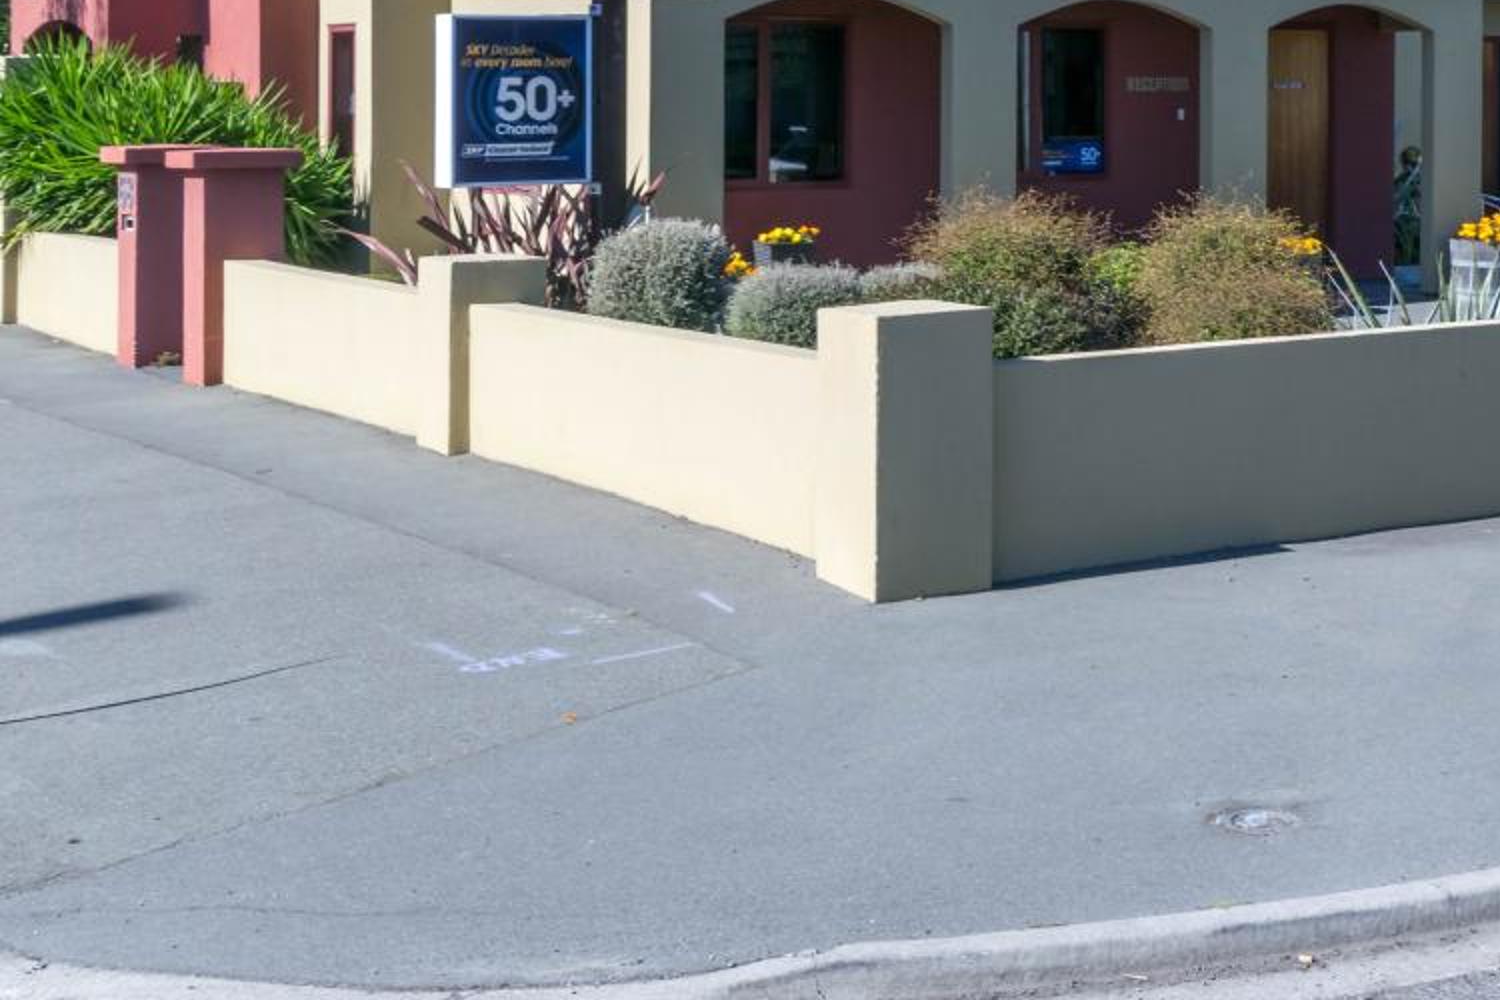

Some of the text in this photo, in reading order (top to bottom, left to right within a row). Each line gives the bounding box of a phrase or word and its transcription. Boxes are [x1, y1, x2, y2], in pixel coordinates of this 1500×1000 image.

[474, 57, 508, 71] every
[509, 57, 543, 68] room
[495, 75, 576, 122] 50+
[495, 122, 559, 135] Channels
